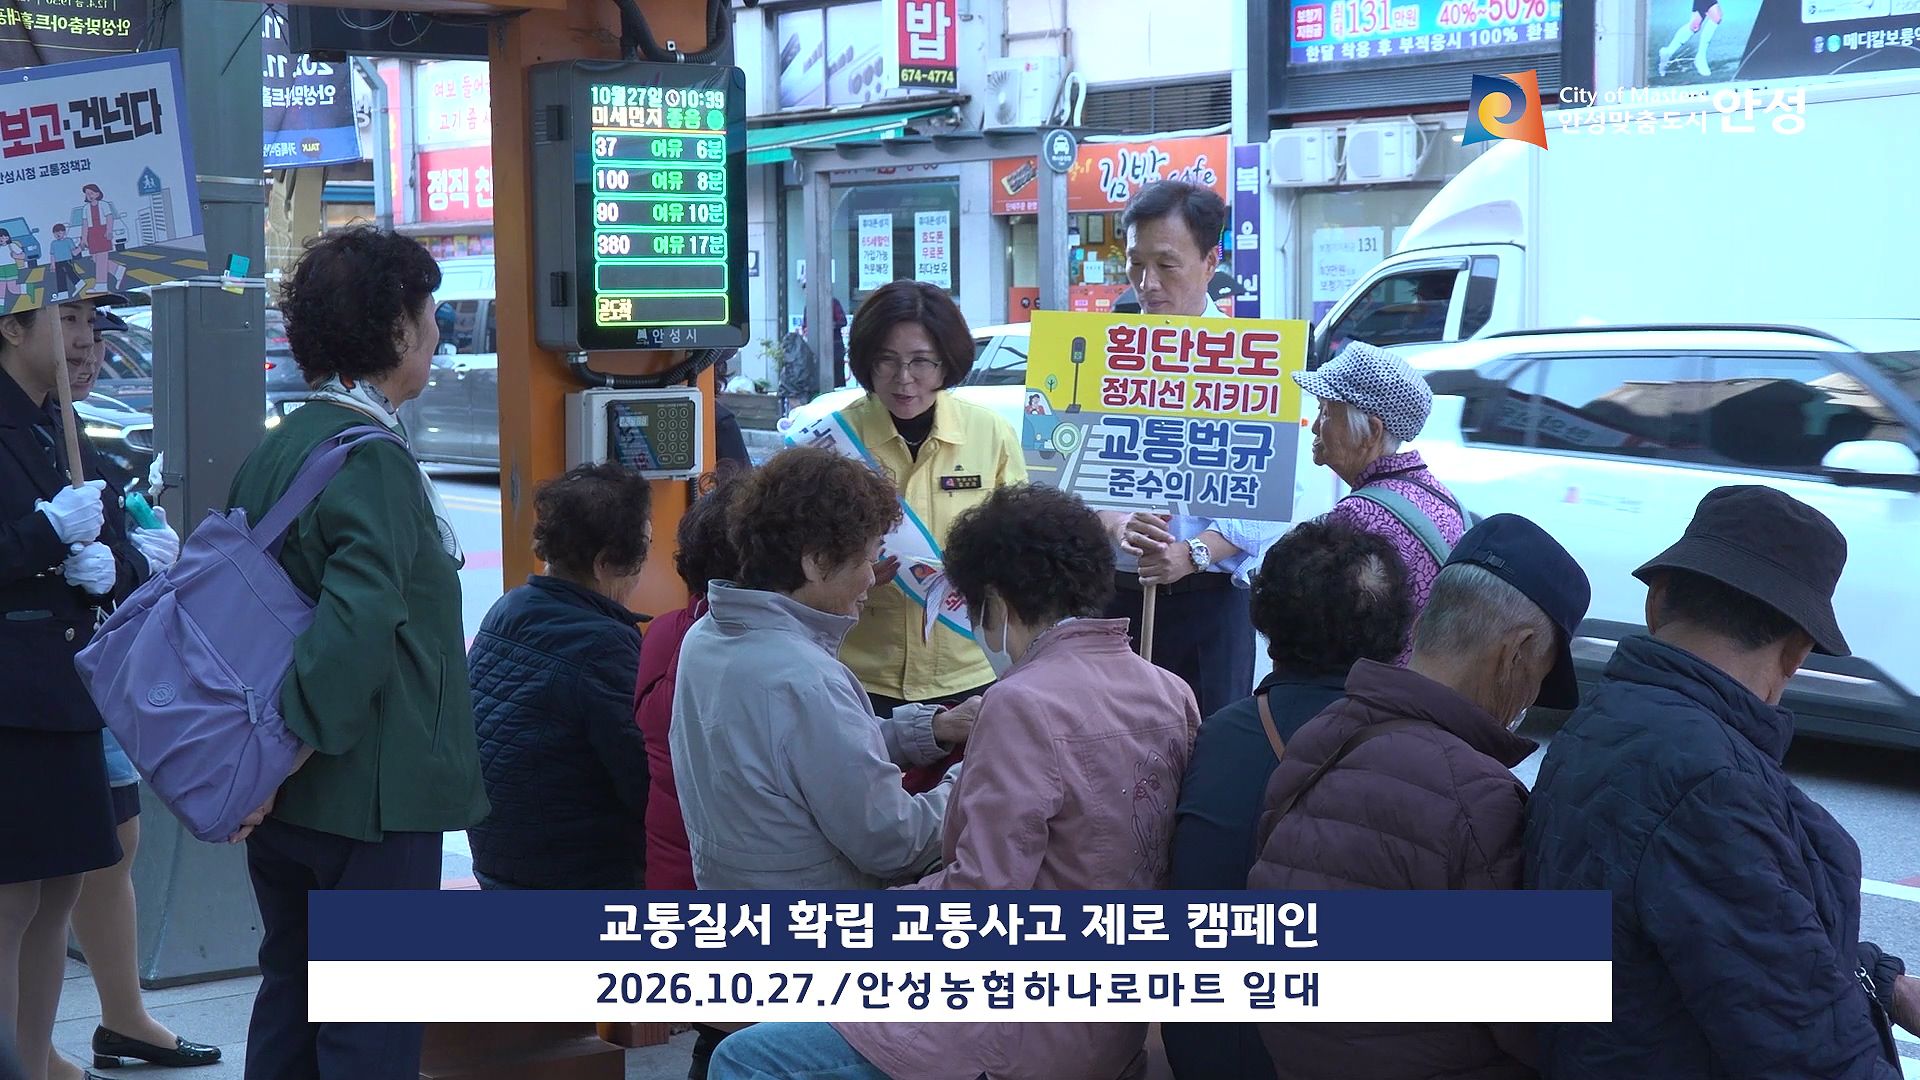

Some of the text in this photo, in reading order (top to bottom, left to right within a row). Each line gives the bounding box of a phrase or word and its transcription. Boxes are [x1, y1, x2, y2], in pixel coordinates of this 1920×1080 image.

[905, 1, 952, 61] 밥
[1306, 44, 1335, 62] 한달
[1341, 40, 1371, 59] 착용
[1377, 38, 1393, 56] 후
[1469, 26, 1519, 47] 100%
[1526, 22, 1559, 41] 환불
[434, 73, 490, 98] 여보 들어
[901, 68, 955, 84] 674-4774
[590, 85, 725, 109] 10월27일 10:39
[439, 108, 462, 131] 고기
[591, 105, 702, 130] 미세먼지 좋음
[595, 137, 722, 160] 37 여유 6분
[39, 158, 92, 178] 교통정책과
[427, 167, 470, 212] 정직
[596, 169, 723, 191] 100 여유 8분
[596, 202, 724, 223] 90 여유 10분
[597, 234, 724, 255] 380 여유 17분
[921, 230, 944, 244] 효도폰
[922, 246, 944, 260] 무료폰
[918, 261, 948, 275] 최다보유
[1106, 325, 1280, 377] 횡단보도
[1102, 377, 1279, 414] 정지선 지키기
[1099, 416, 1275, 471] 교통법규
[1108, 468, 1260, 507] 준수의 시작
